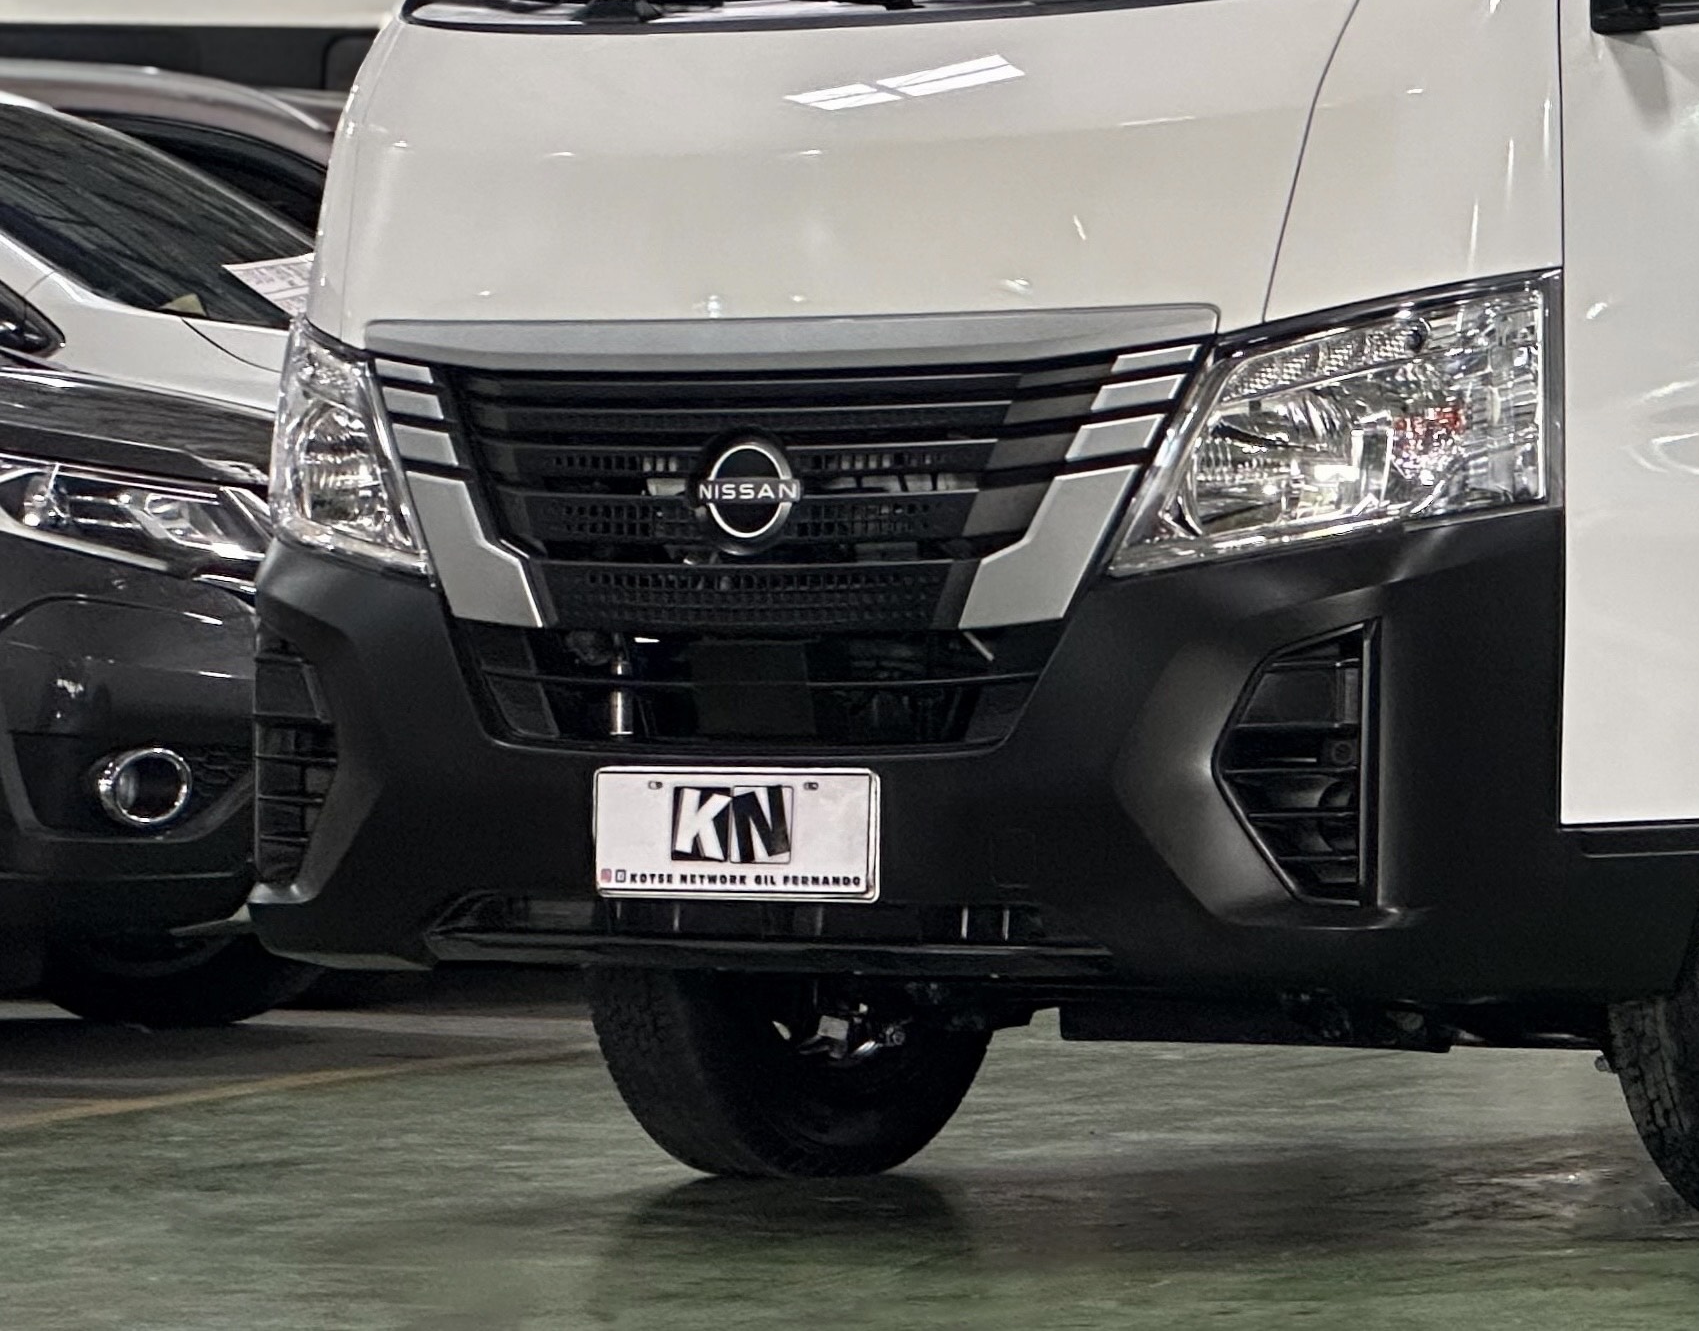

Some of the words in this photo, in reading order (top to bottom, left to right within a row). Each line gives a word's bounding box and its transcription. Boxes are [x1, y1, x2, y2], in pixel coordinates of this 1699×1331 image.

[699, 483, 797, 500] NISSAN
[629, 873, 674, 885] KOTSE
[679, 874, 747, 886] NETWORK
[754, 875, 777, 886] GIL
[782, 875, 862, 887] FERNANDO
